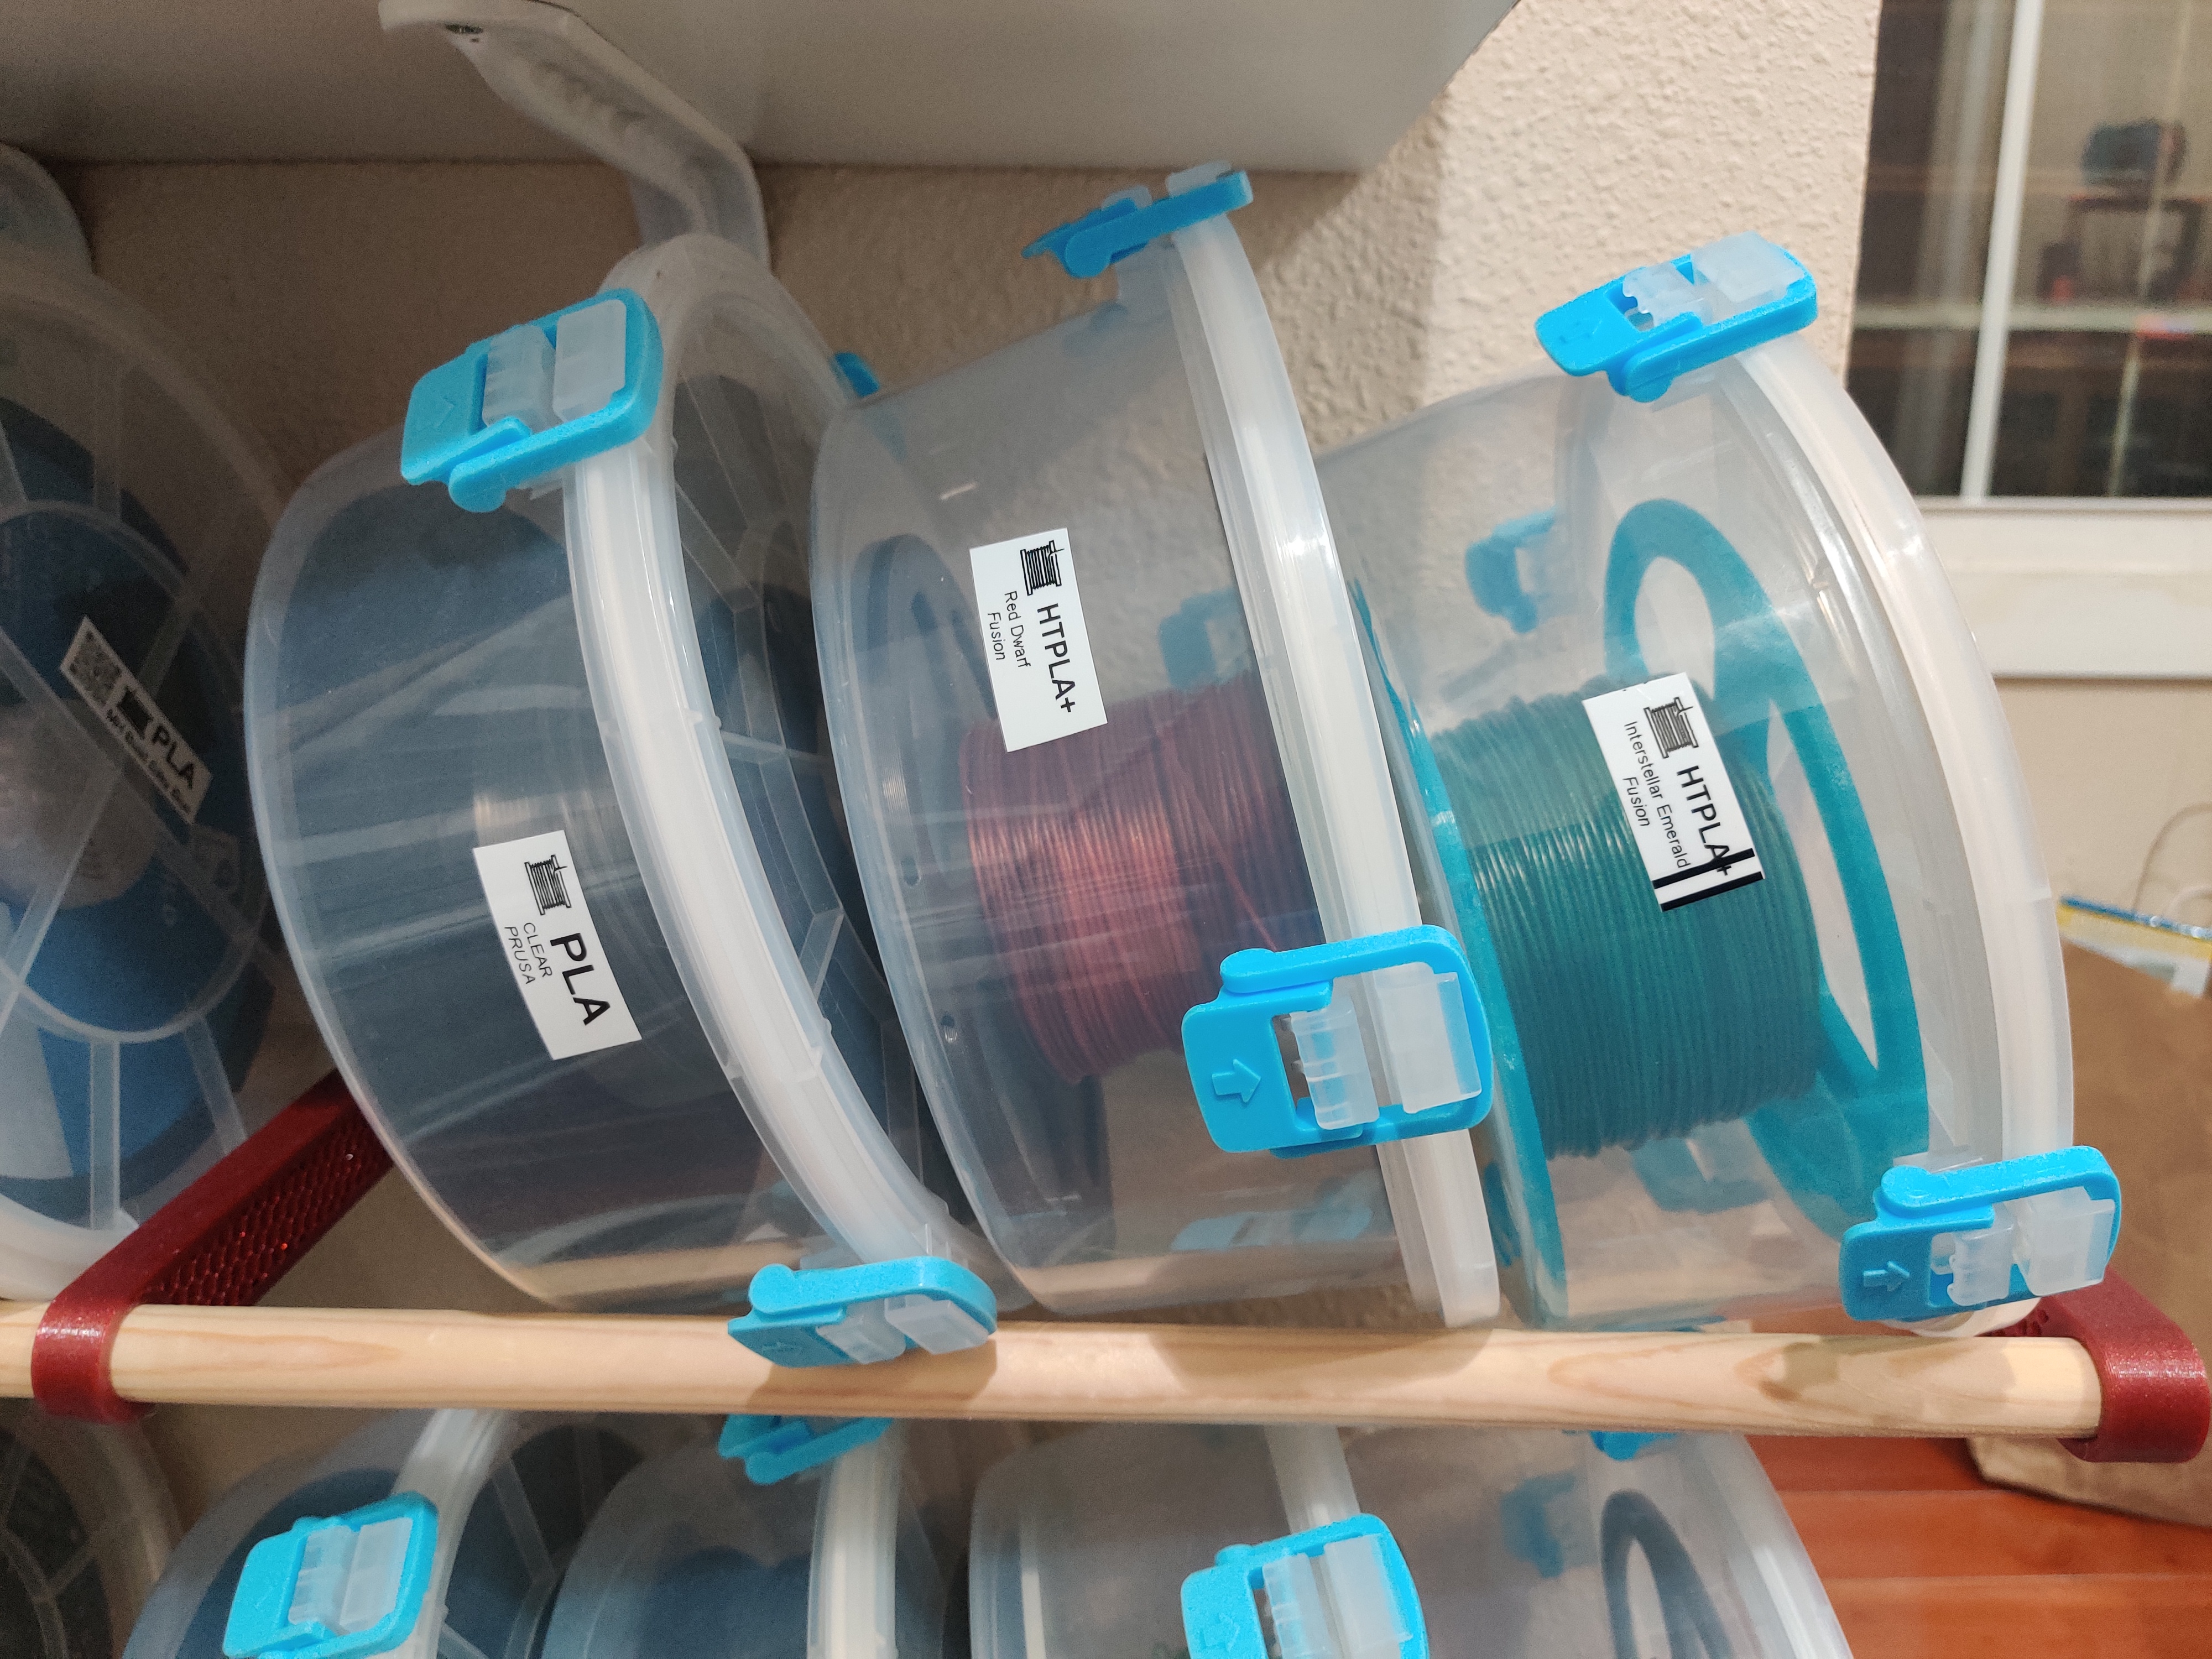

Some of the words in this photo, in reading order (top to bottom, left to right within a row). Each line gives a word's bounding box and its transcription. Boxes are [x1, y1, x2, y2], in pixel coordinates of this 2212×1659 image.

[1004, 591, 1021, 621] Red
[987, 612, 1006, 660] Fusion
[1010, 624, 1031, 668] Dwarf
[1037, 603, 1076, 713] HTPLA+
[151, 724, 194, 790] PLA
[1623, 777, 1651, 827] Fusion
[1624, 721, 1663, 800] Interstellar
[1657, 804, 1692, 869] Emerald
[1676, 765, 1732, 876] HTPLA+
[504, 926, 536, 984] PRUSA
[523, 922, 552, 978] CLEAR
[550, 932, 611, 1026] PLA
